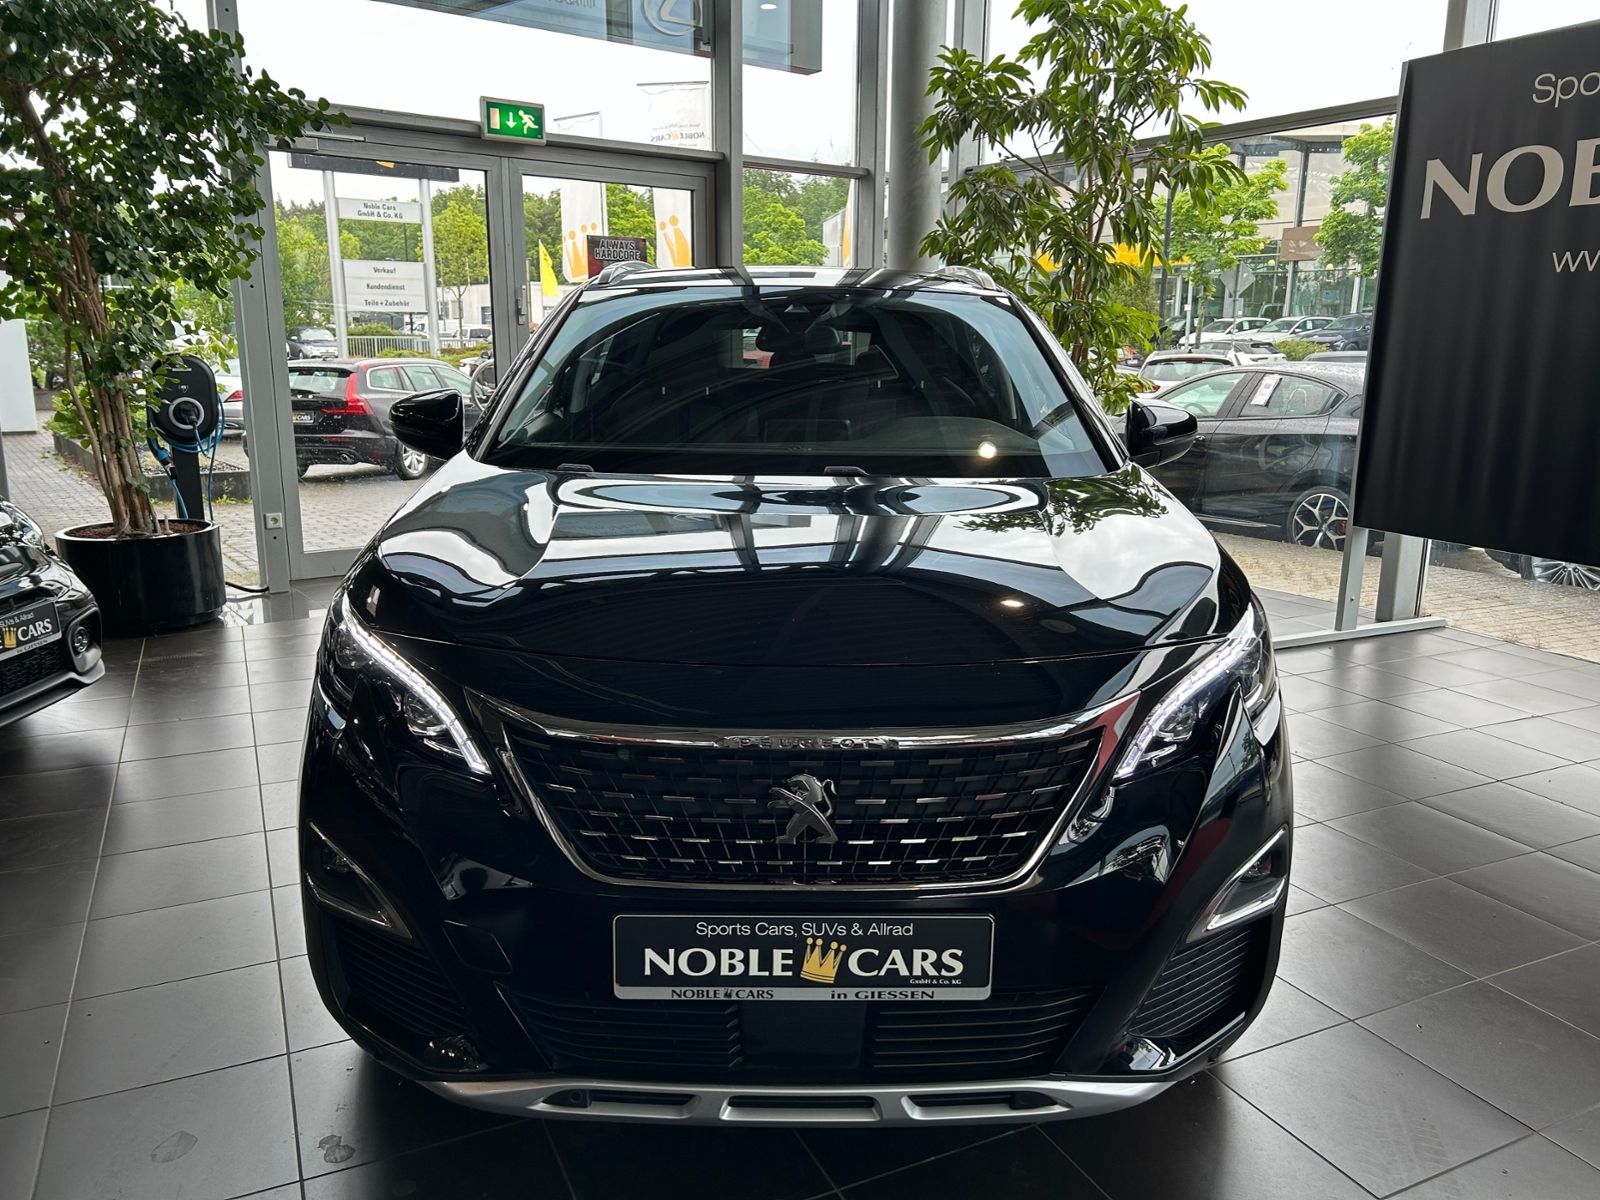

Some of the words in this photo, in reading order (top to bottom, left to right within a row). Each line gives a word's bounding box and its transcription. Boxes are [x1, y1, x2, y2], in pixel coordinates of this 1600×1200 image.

[1532, 72, 1600, 108] Spo
[600, 239, 635, 250] ALWAYS
[594, 248, 641, 260] HARDCORE
[17, 618, 52, 641] CARS
[696, 921, 751, 938] Sports
[755, 922, 798, 937] Cars,
[801, 922, 847, 936] SUVs
[851, 922, 864, 936] &
[867, 922, 914, 936] Allrad
[644, 947, 794, 976] NOBLE
[847, 948, 964, 977] CARS
[671, 989, 721, 999] NOBLE
[735, 989, 774, 999] CARS
[831, 990, 848, 999] in
[854, 990, 935, 1000] GIESSEN
